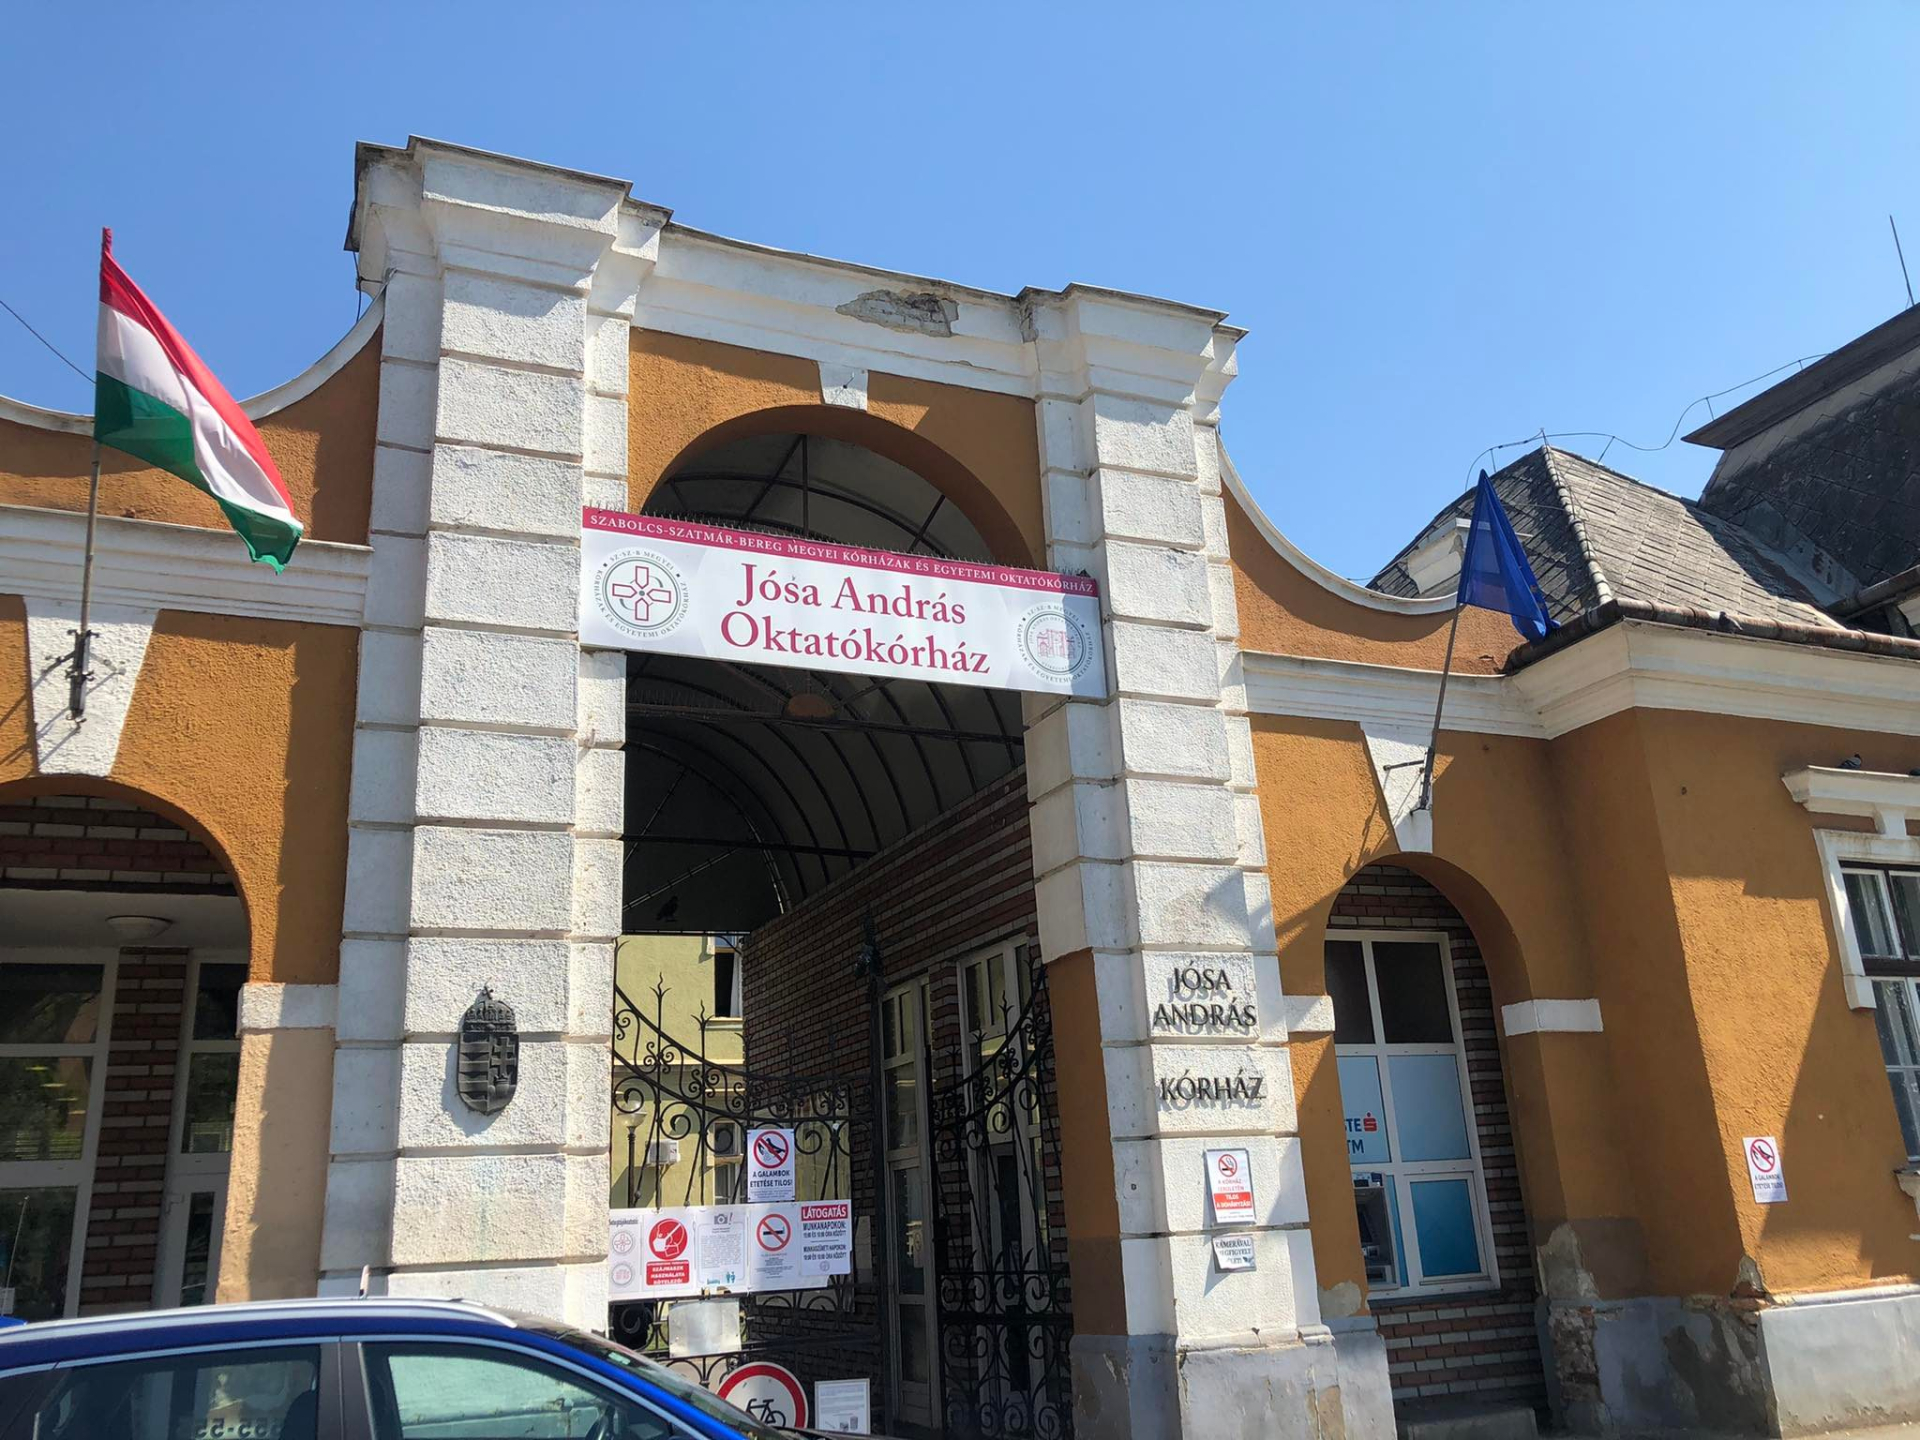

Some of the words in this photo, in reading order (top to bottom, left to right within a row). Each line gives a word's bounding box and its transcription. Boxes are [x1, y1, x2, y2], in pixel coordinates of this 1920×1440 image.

[590, 515, 782, 551] SZABOLCS-SZATMÁR-BEREG
[788, 543, 837, 560] MEGYEI
[842, 551, 911, 569] KÓRHÁZAK
[916, 561, 929, 572] ÉS
[934, 564, 996, 580] EGYETEMI
[1000, 573, 1094, 593] OKTATÓKÓRHÁZ
[737, 563, 822, 607] Jósa
[831, 576, 966, 624] András
[721, 611, 990, 674] Oktatókórház
[1173, 961, 1232, 993] JÓSA
[1153, 997, 1257, 1027] ANDRÁS
[1160, 1069, 1267, 1100] KÓRHÁZ
[802, 1205, 847, 1219] LÁTOGATÁS
